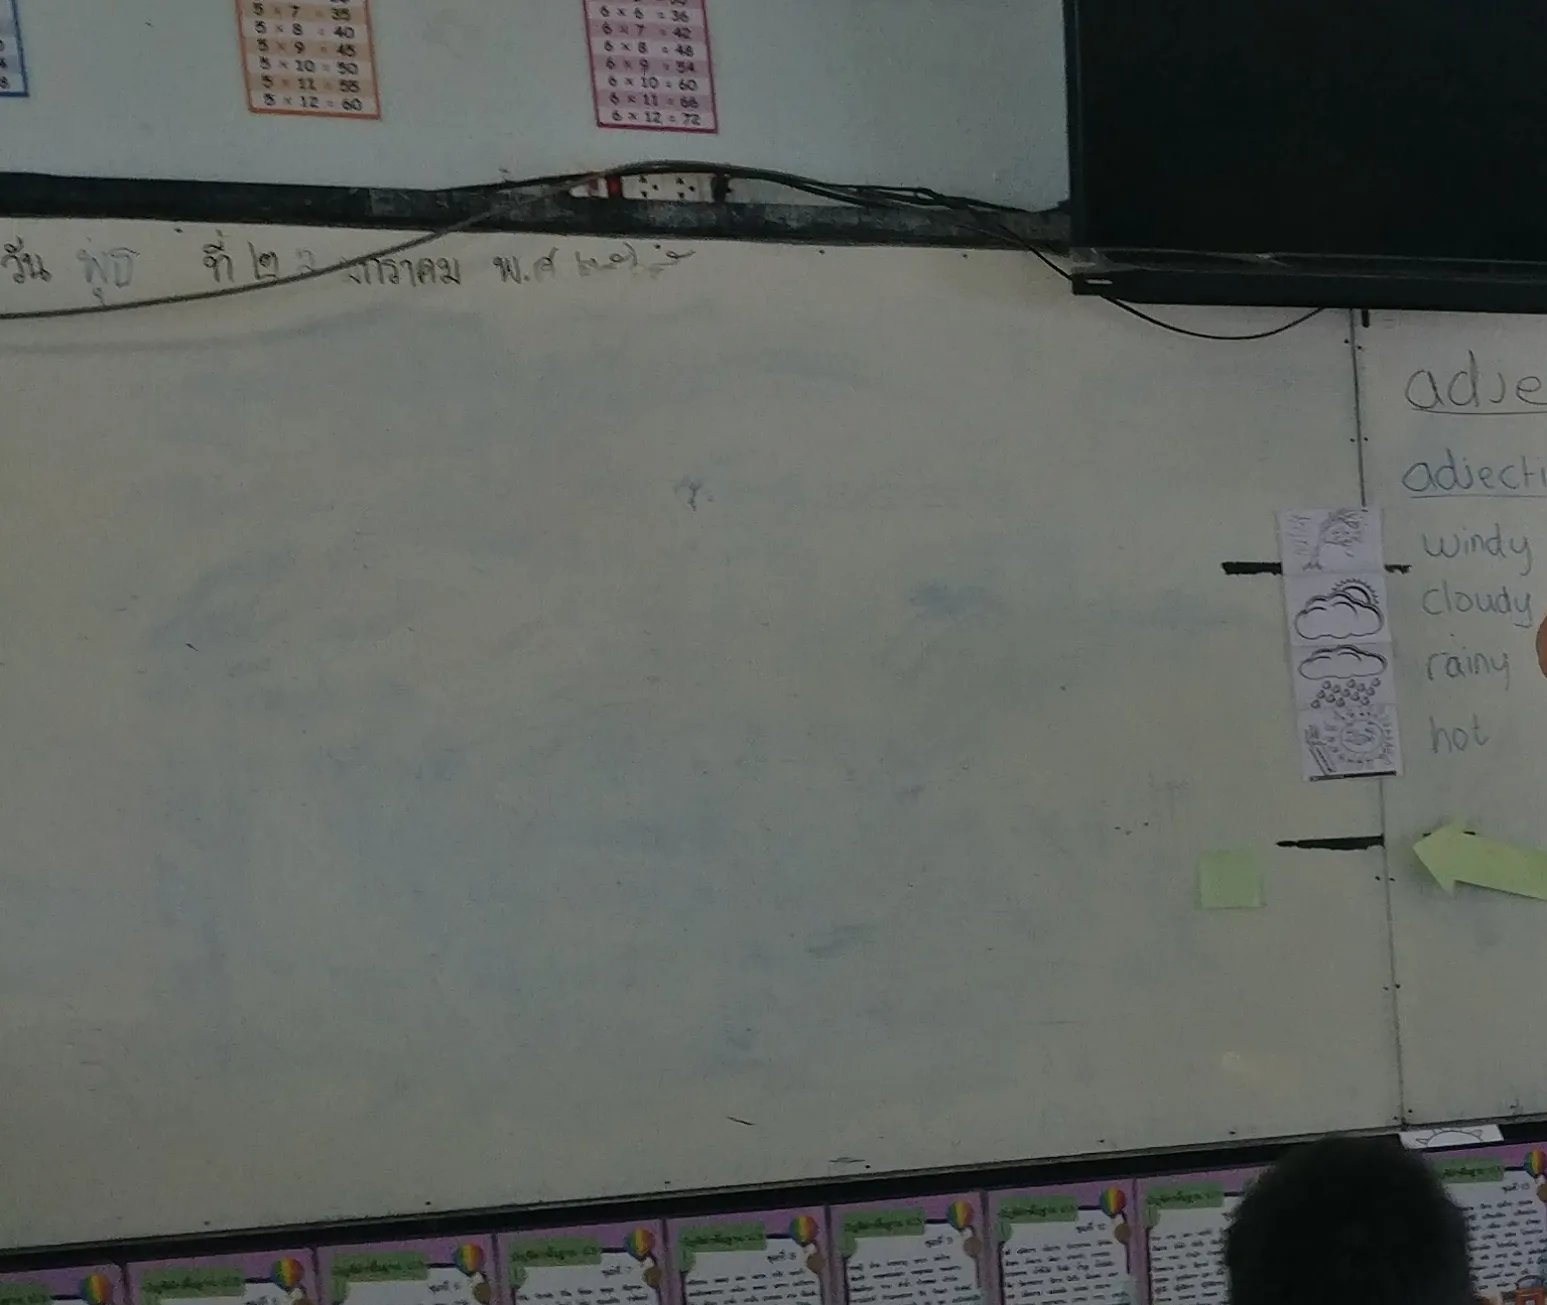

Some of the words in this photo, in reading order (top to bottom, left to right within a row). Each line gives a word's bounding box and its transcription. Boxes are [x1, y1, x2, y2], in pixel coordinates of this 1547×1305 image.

[1423, 522, 1533, 576] windy
[1422, 584, 1533, 628] cloudy
[1425, 632, 1512, 679] rainy
[1429, 716, 1491, 754] hot
